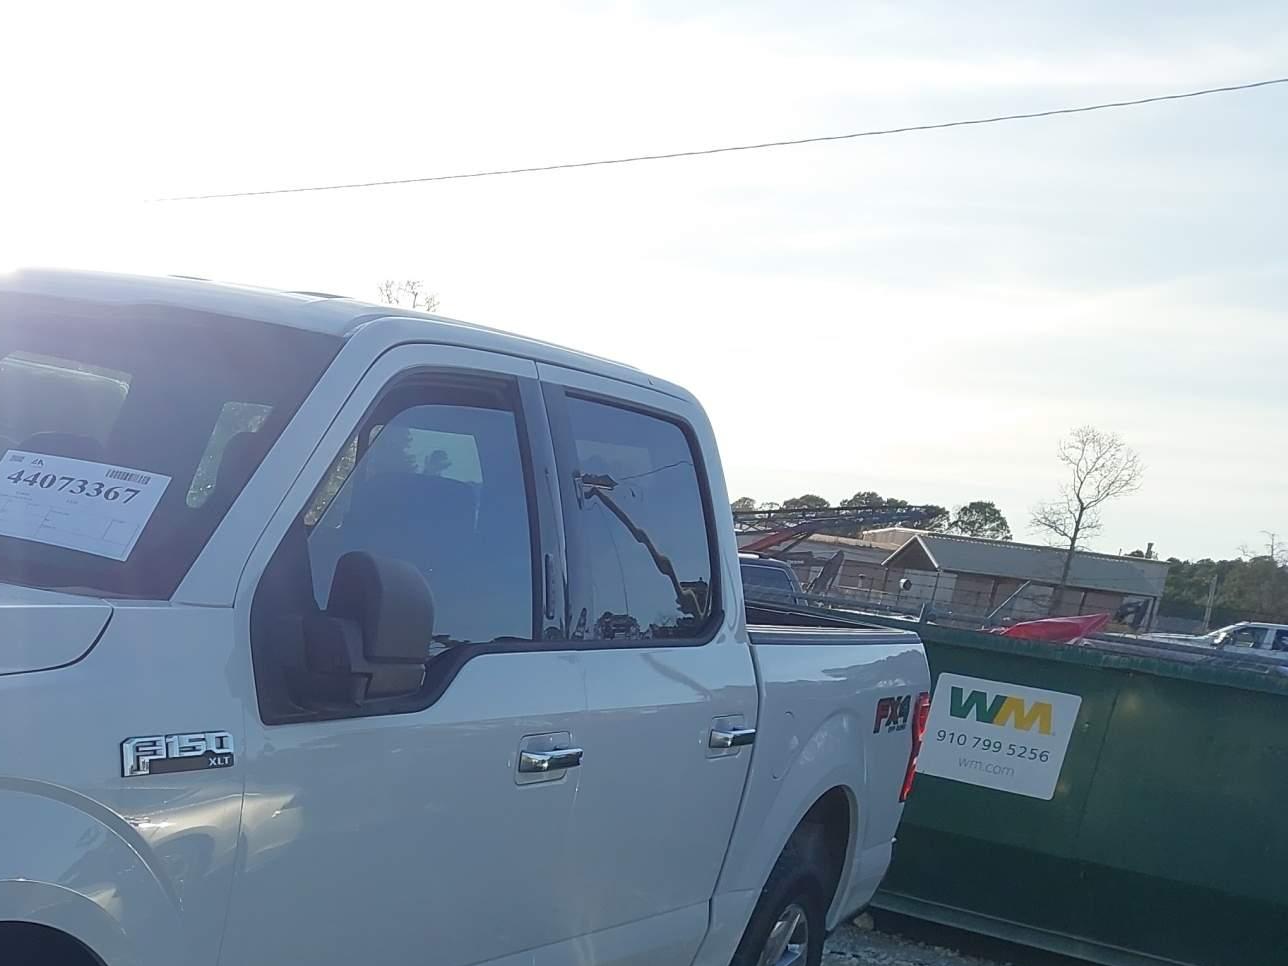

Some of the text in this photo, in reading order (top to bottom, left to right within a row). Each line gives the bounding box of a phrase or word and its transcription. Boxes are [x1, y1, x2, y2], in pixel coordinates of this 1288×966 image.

[7, 469, 141, 504] 44073367
[949, 686, 1053, 736] WM
[209, 756, 231, 766] XLT
[936, 729, 1050, 763] 910 799 5256
[958, 757, 1015, 776] wm.com
